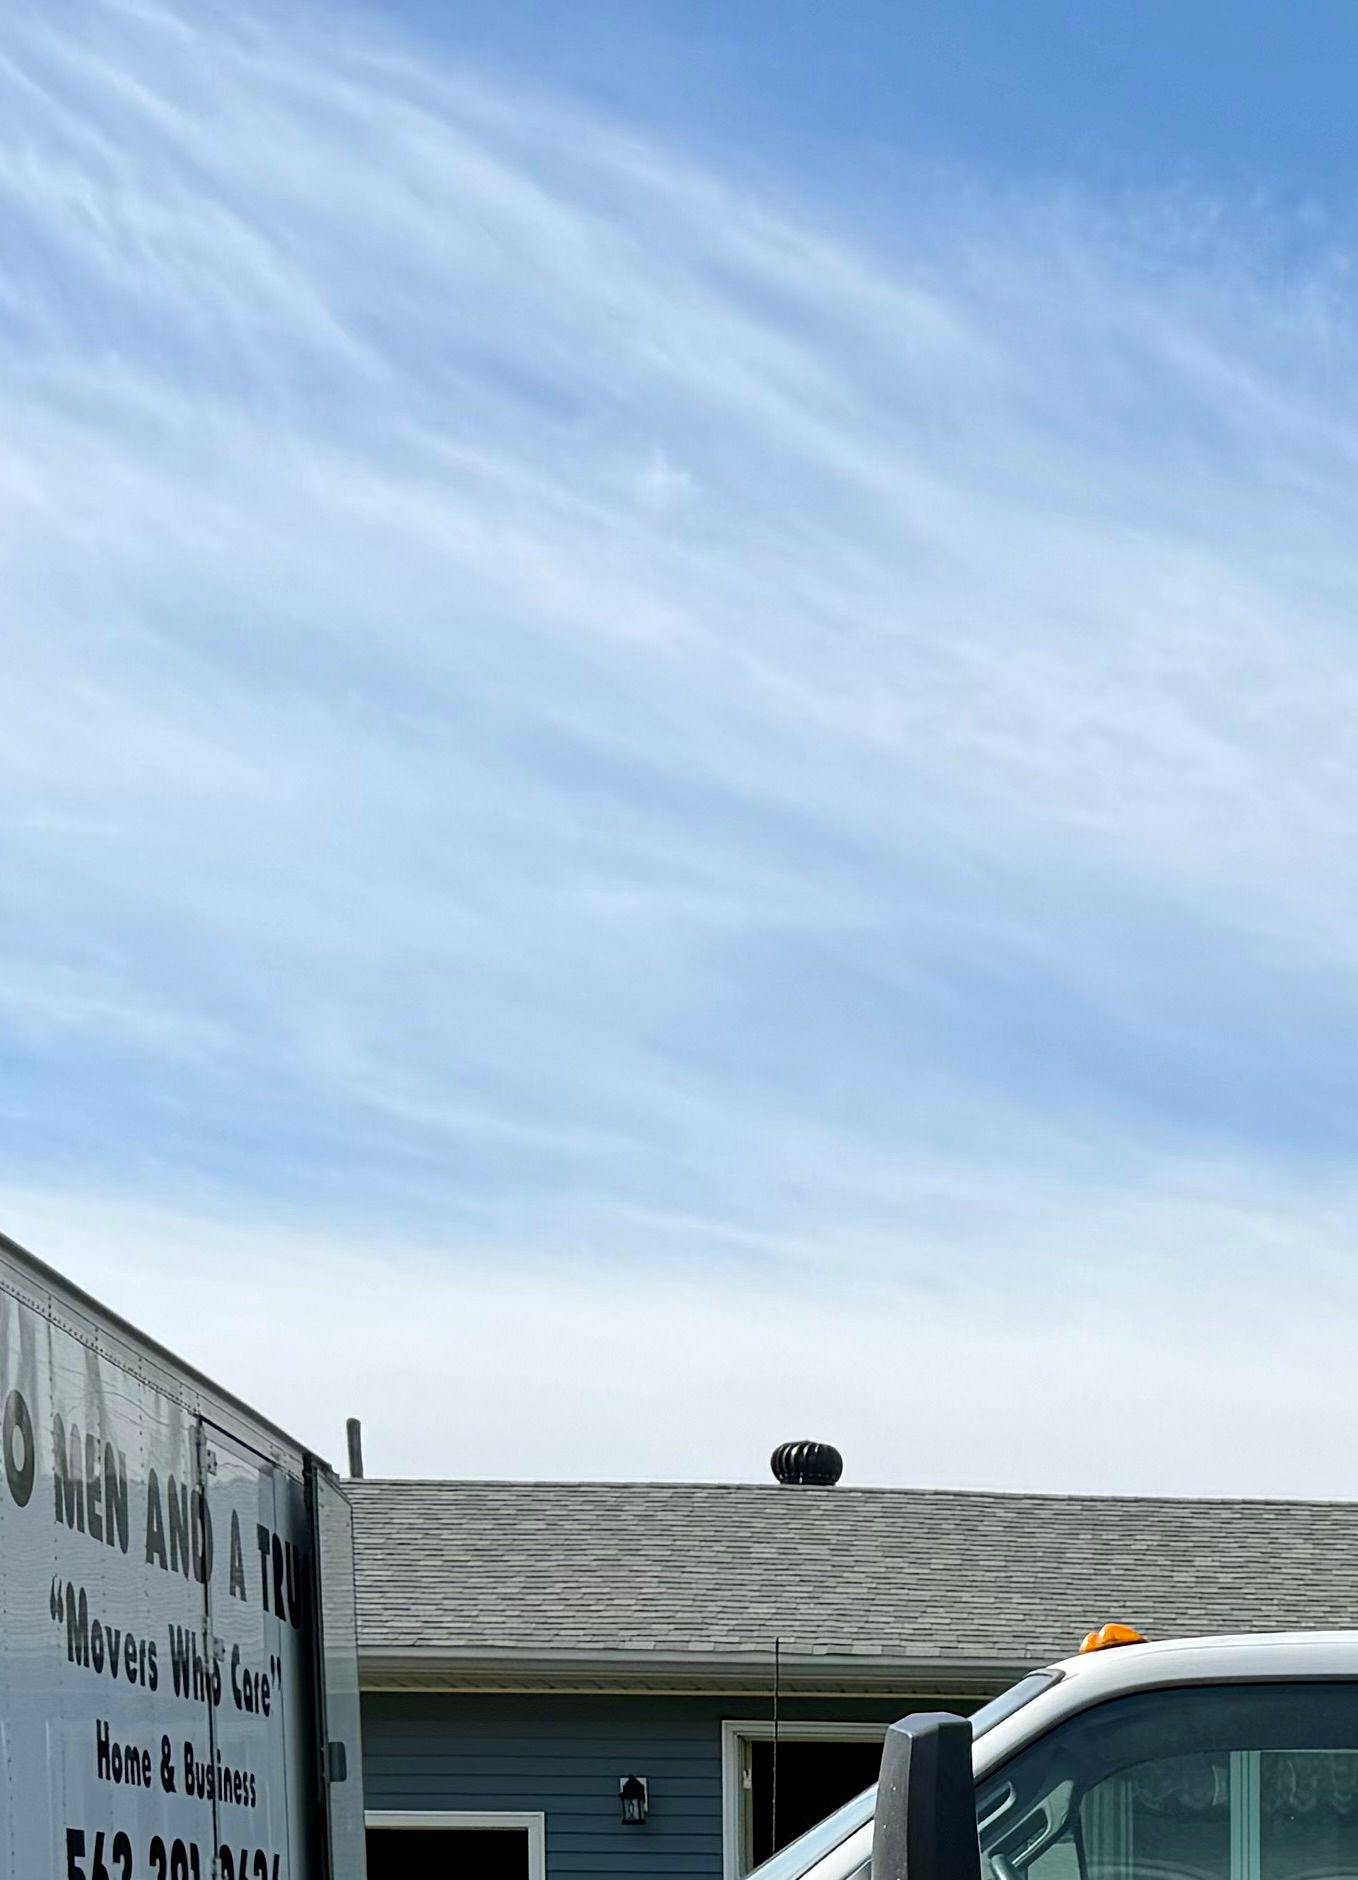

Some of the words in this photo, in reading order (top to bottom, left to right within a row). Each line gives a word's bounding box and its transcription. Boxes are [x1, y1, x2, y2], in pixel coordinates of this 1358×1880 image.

[53, 1413, 129, 1554] MEN
[145, 1467, 214, 1585] AND
[229, 1508, 247, 1602] A
[256, 1522, 303, 1630] TRU
[168, 1623, 221, 1707] Who
[96, 1719, 151, 1789] Home
[160, 1734, 177, 1794] &
[184, 1741, 257, 1809] Business
